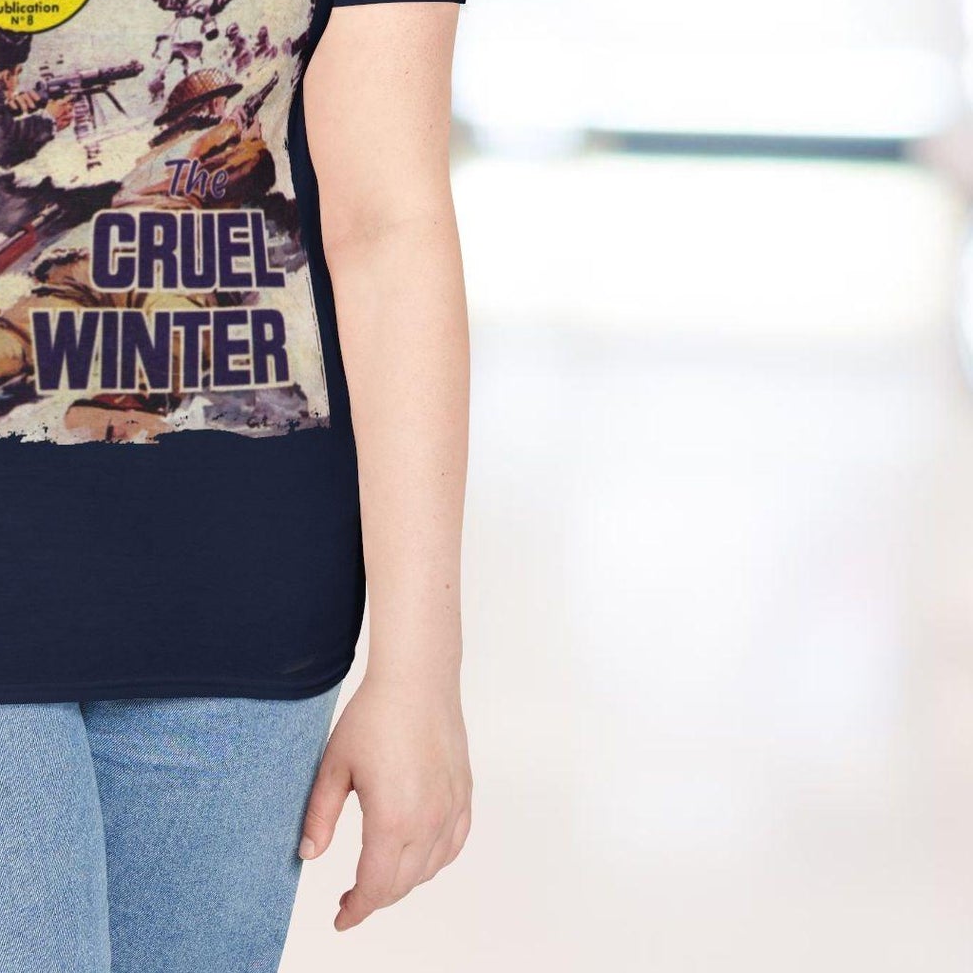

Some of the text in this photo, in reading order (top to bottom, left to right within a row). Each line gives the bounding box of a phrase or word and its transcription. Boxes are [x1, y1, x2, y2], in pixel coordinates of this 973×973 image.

[164, 158, 228, 200] The
[89, 208, 288, 292] CRUEL
[29, 307, 293, 394] WINTER
